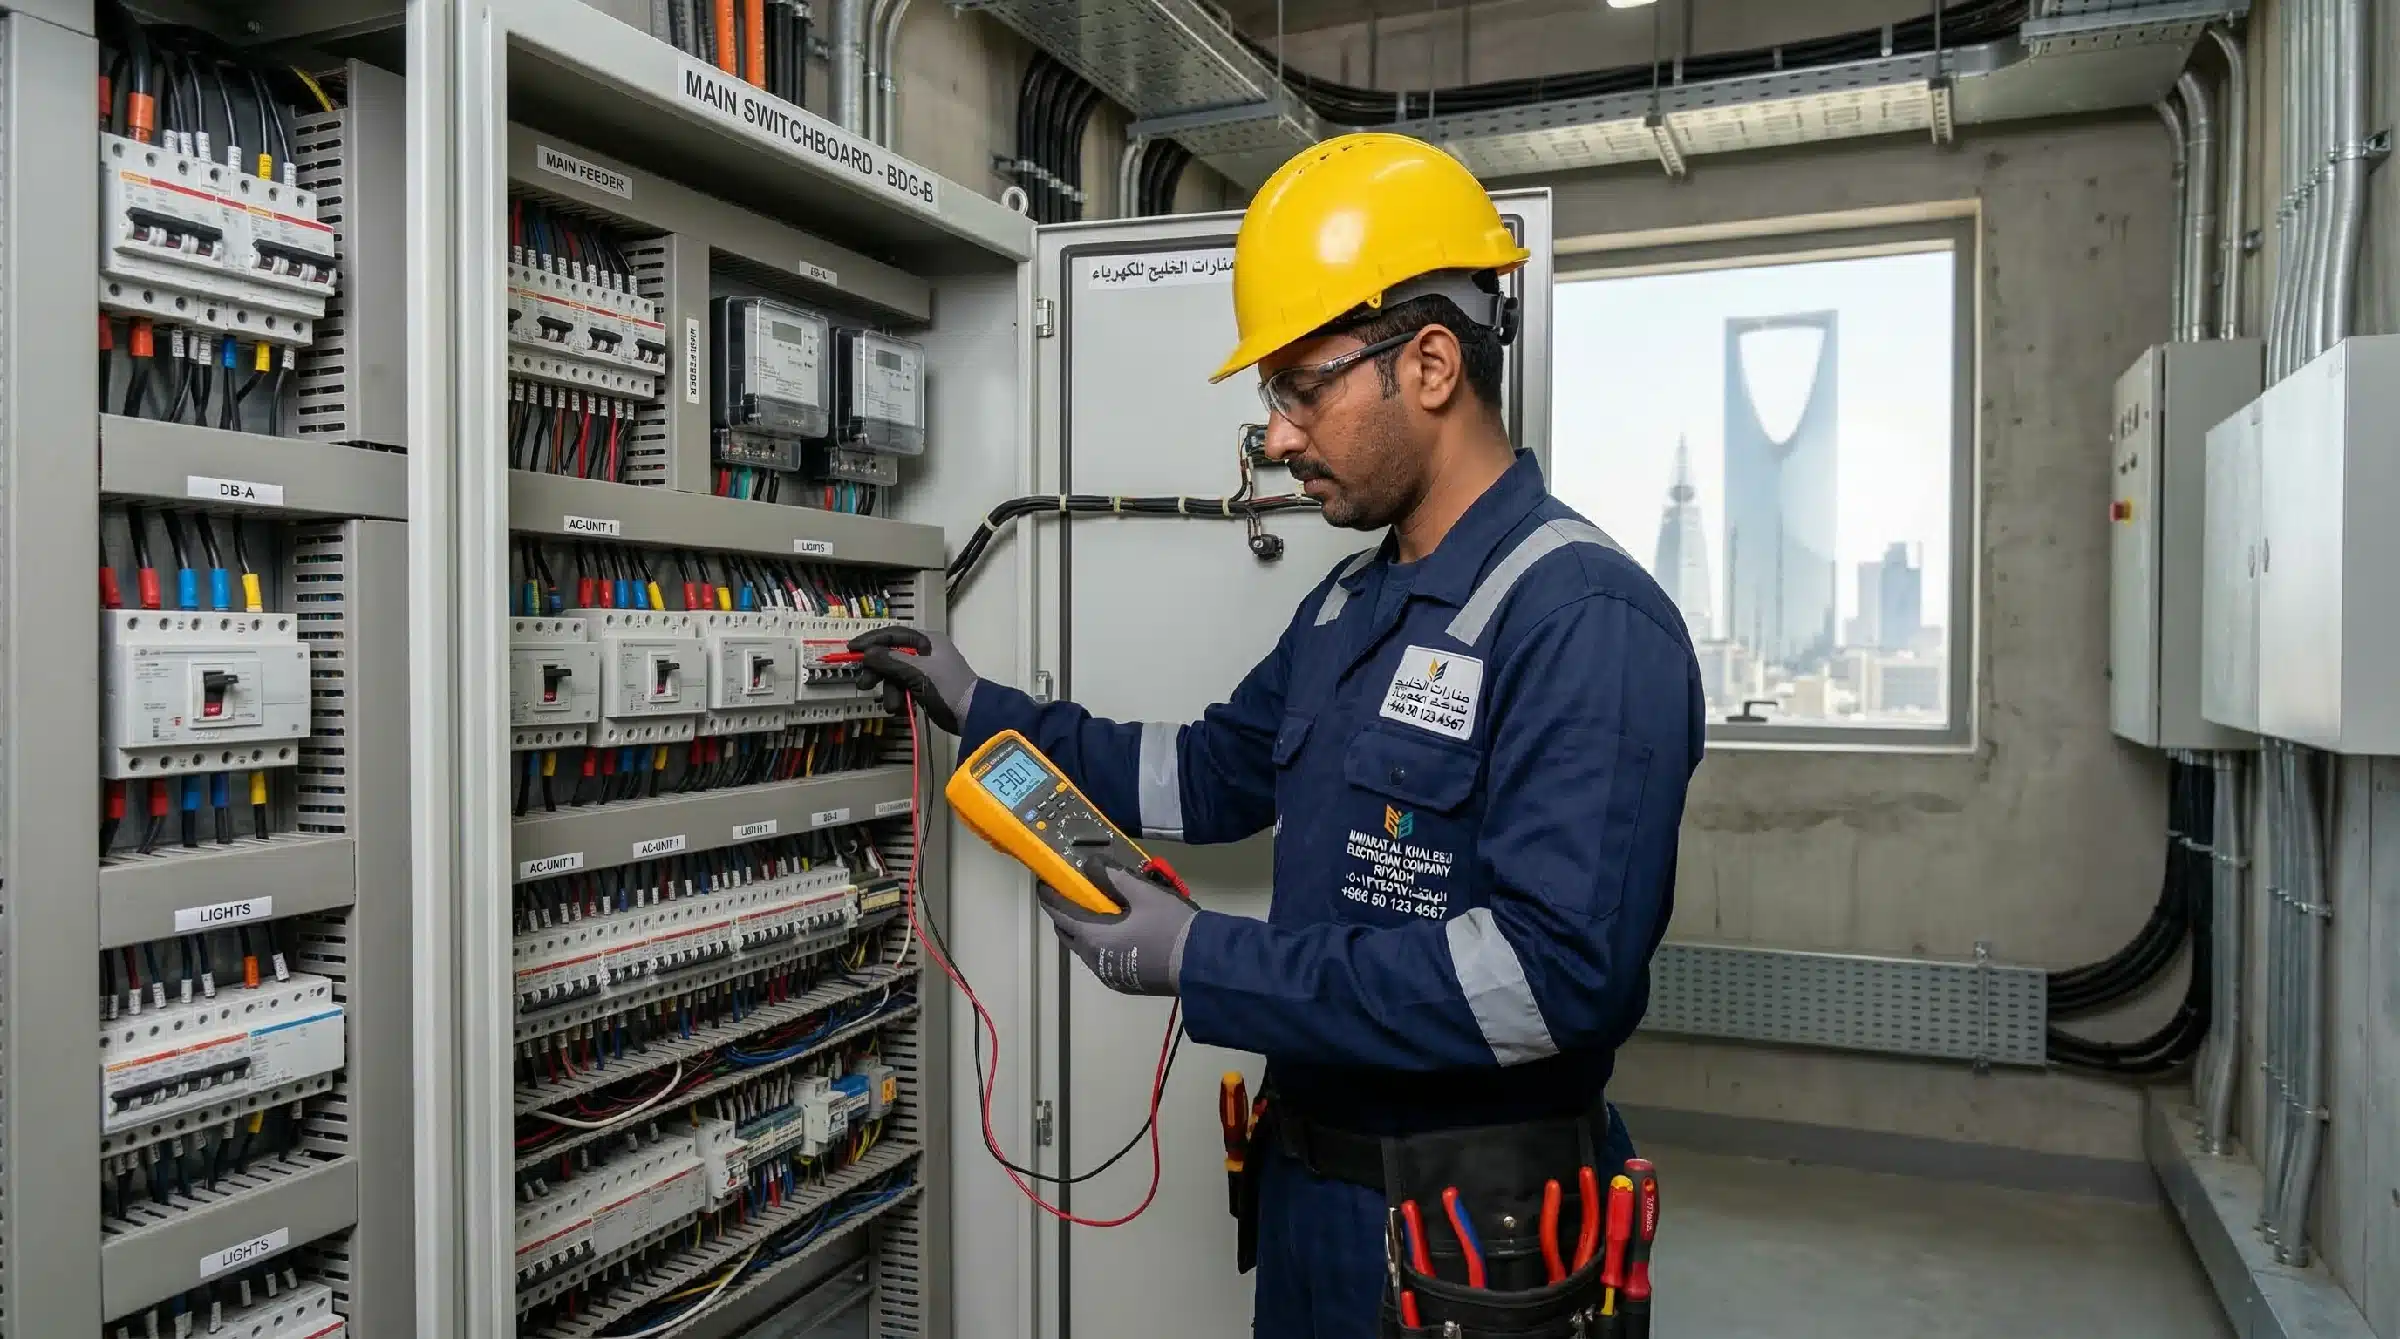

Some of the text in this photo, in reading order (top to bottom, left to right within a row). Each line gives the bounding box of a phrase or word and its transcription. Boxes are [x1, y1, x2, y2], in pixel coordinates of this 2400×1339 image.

[685, 69, 737, 117] MAIN
[743, 98, 873, 175] SWITCHBOARD
[886, 163, 934, 203] BDG-B
[546, 152, 625, 192] MAIN FEEDER
[1092, 261, 1144, 283] للكهرباء
[1148, 260, 1187, 282] الخليج
[220, 483, 255, 499] DB-A
[569, 519, 613, 534] AC-UNIT 1
[1420, 708, 1436, 723] 123
[641, 839, 673, 854] AC-UNIT
[1389, 840, 1402, 854] AL
[530, 856, 575, 874] AC-UNIT 1
[1373, 864, 1415, 885] RIYADH
[1402, 859, 1452, 878] COMPANY
[200, 903, 251, 922] LIGHTS
[1371, 893, 1387, 908] 50
[1390, 897, 1412, 914] 123
[1414, 902, 1448, 920] 4567
[222, 1238, 269, 1267] LIGHTS
